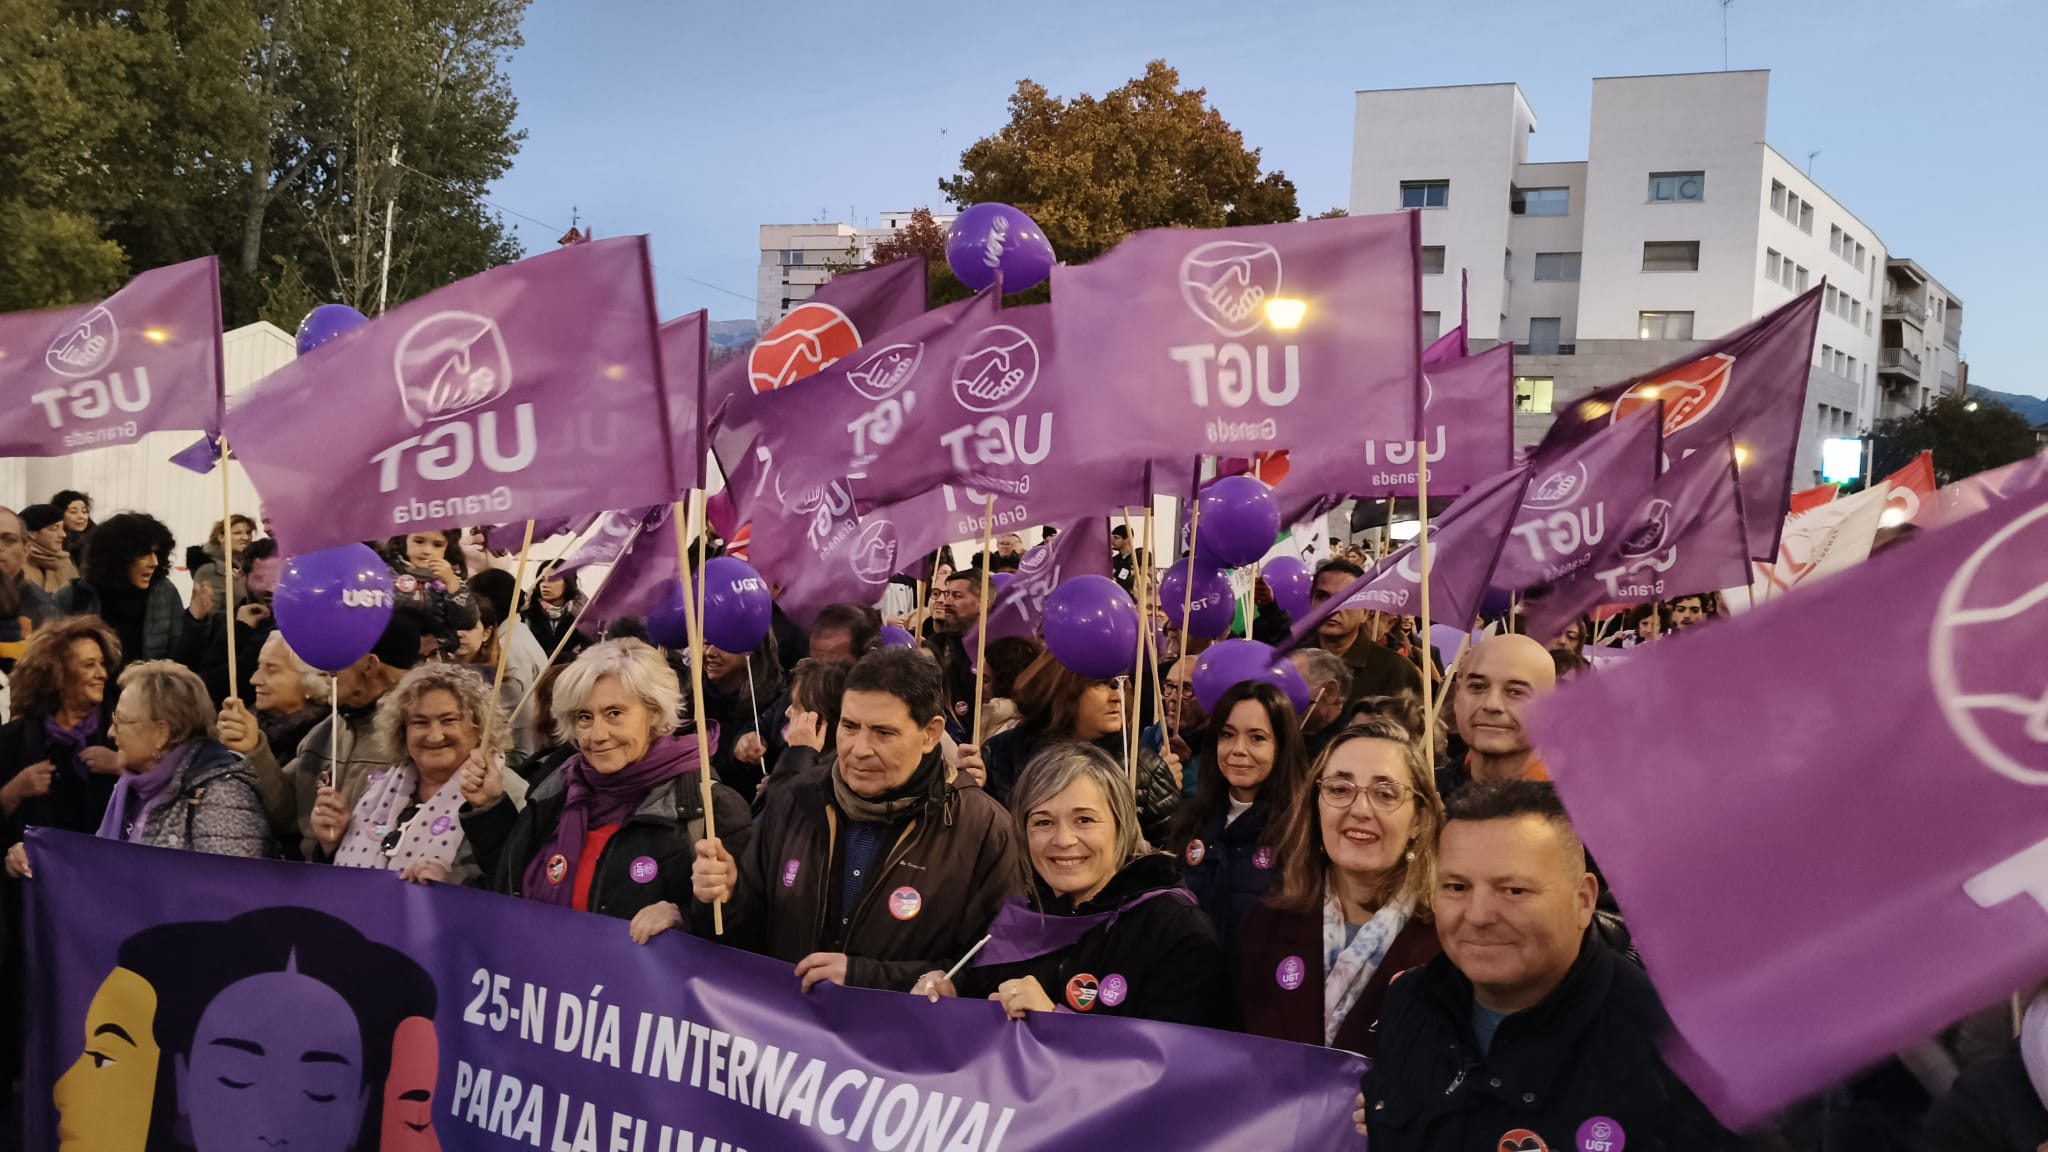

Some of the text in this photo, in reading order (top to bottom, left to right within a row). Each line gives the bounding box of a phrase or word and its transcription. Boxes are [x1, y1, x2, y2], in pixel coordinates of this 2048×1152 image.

[730, 578, 763, 595] UGT
[342, 588, 383, 608] UGT
[1282, 973, 1300, 983] UGT
[1103, 988, 1120, 1000] UGT
[463, 968, 548, 1044] 25-N
[554, 984, 621, 1068] DÍA
[450, 1060, 544, 1147] PARA
[551, 1093, 598, 1152] LA
[1586, 1140, 1613, 1152] UGT
